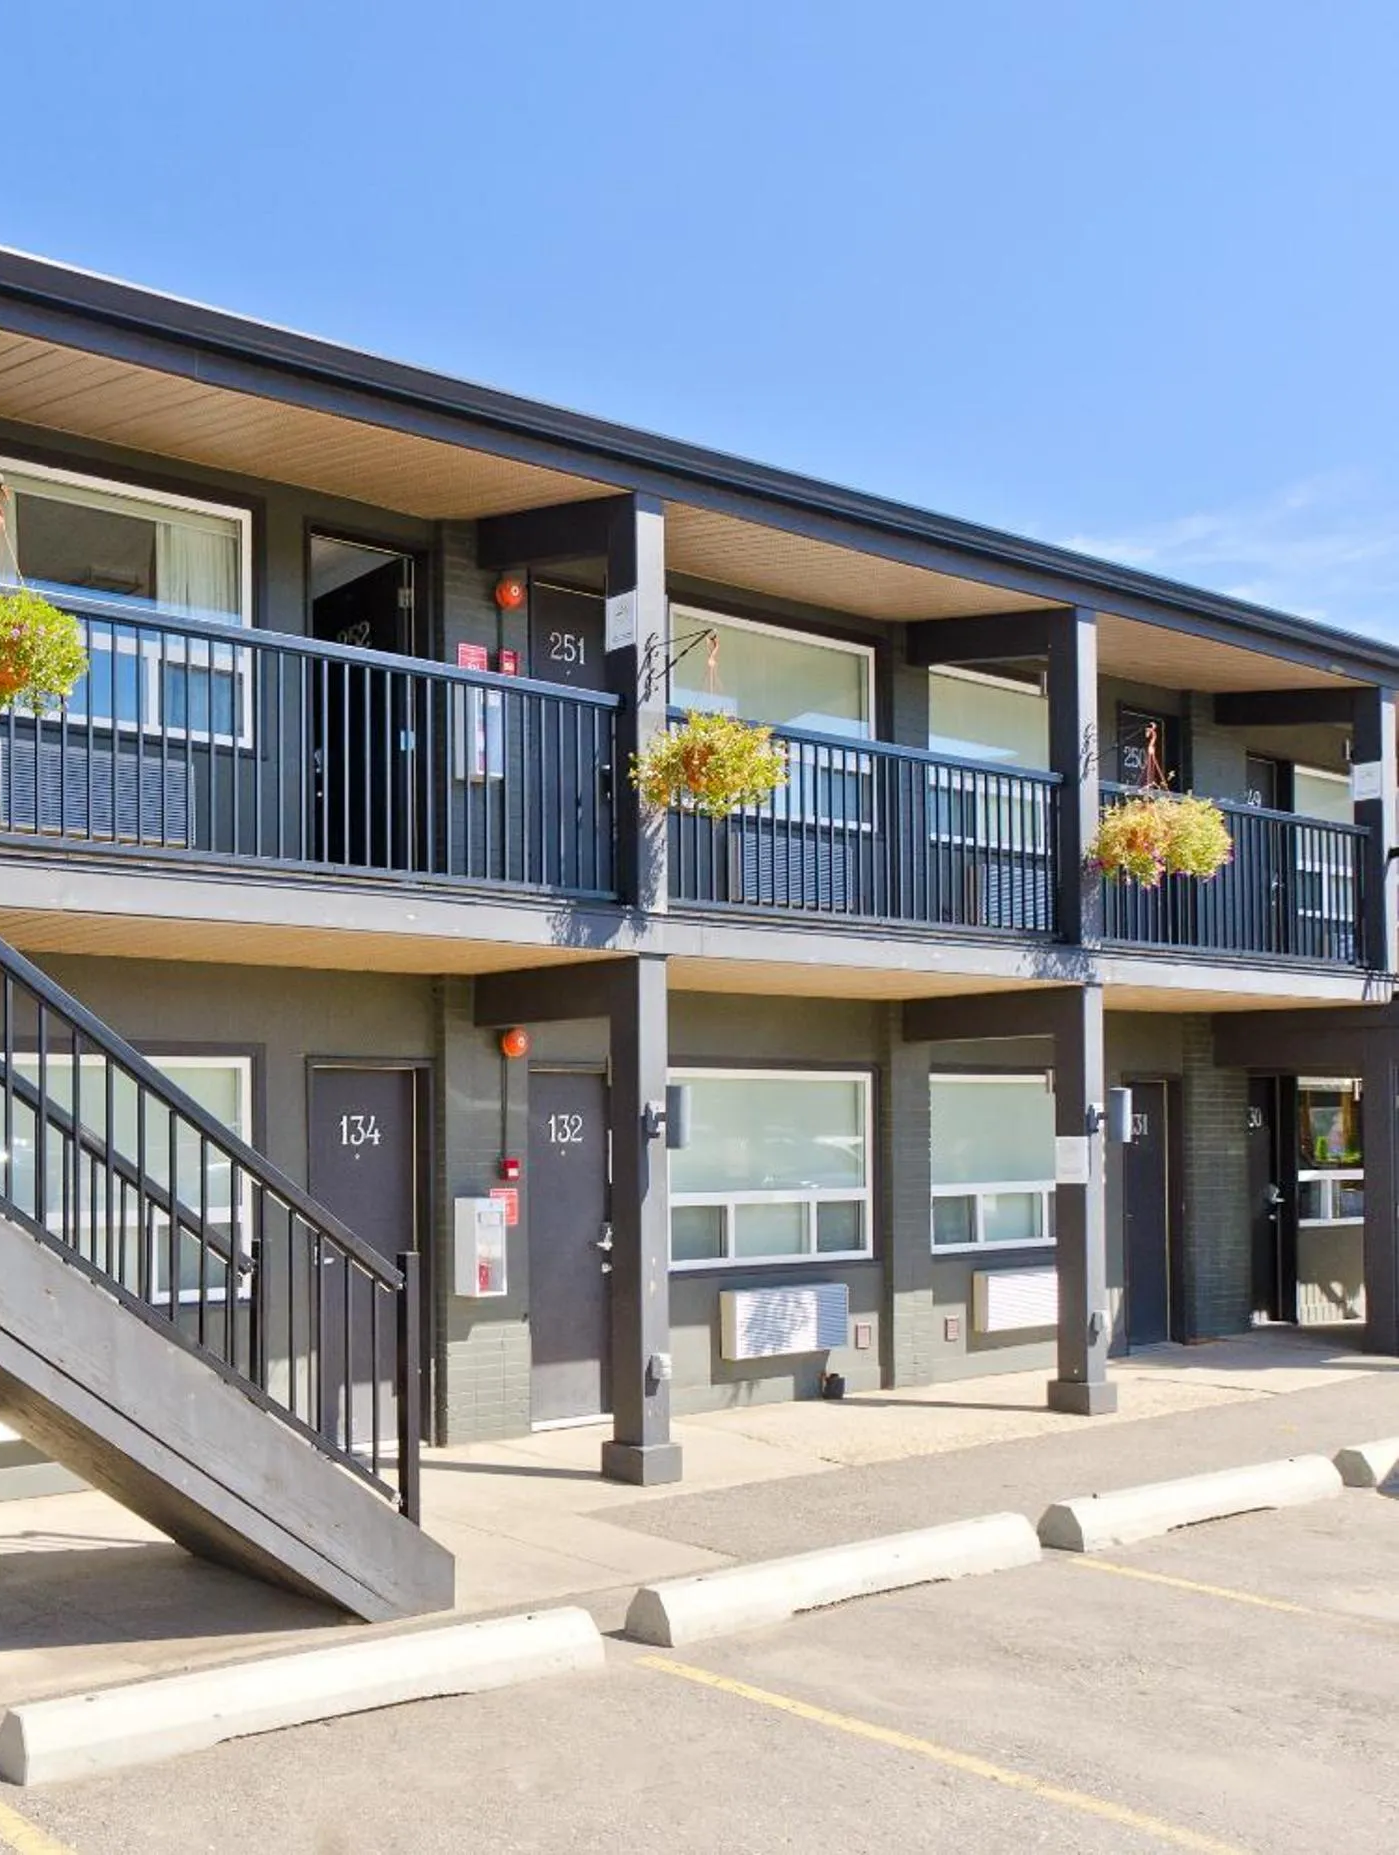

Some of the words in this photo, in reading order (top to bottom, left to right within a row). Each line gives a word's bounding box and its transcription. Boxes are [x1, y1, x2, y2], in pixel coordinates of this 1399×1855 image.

[549, 631, 586, 665] 251
[339, 1115, 381, 1146] 134
[548, 1113, 583, 1143] 132
[1131, 1113, 1149, 1136] 31
[1247, 1106, 1262, 1128] 30
